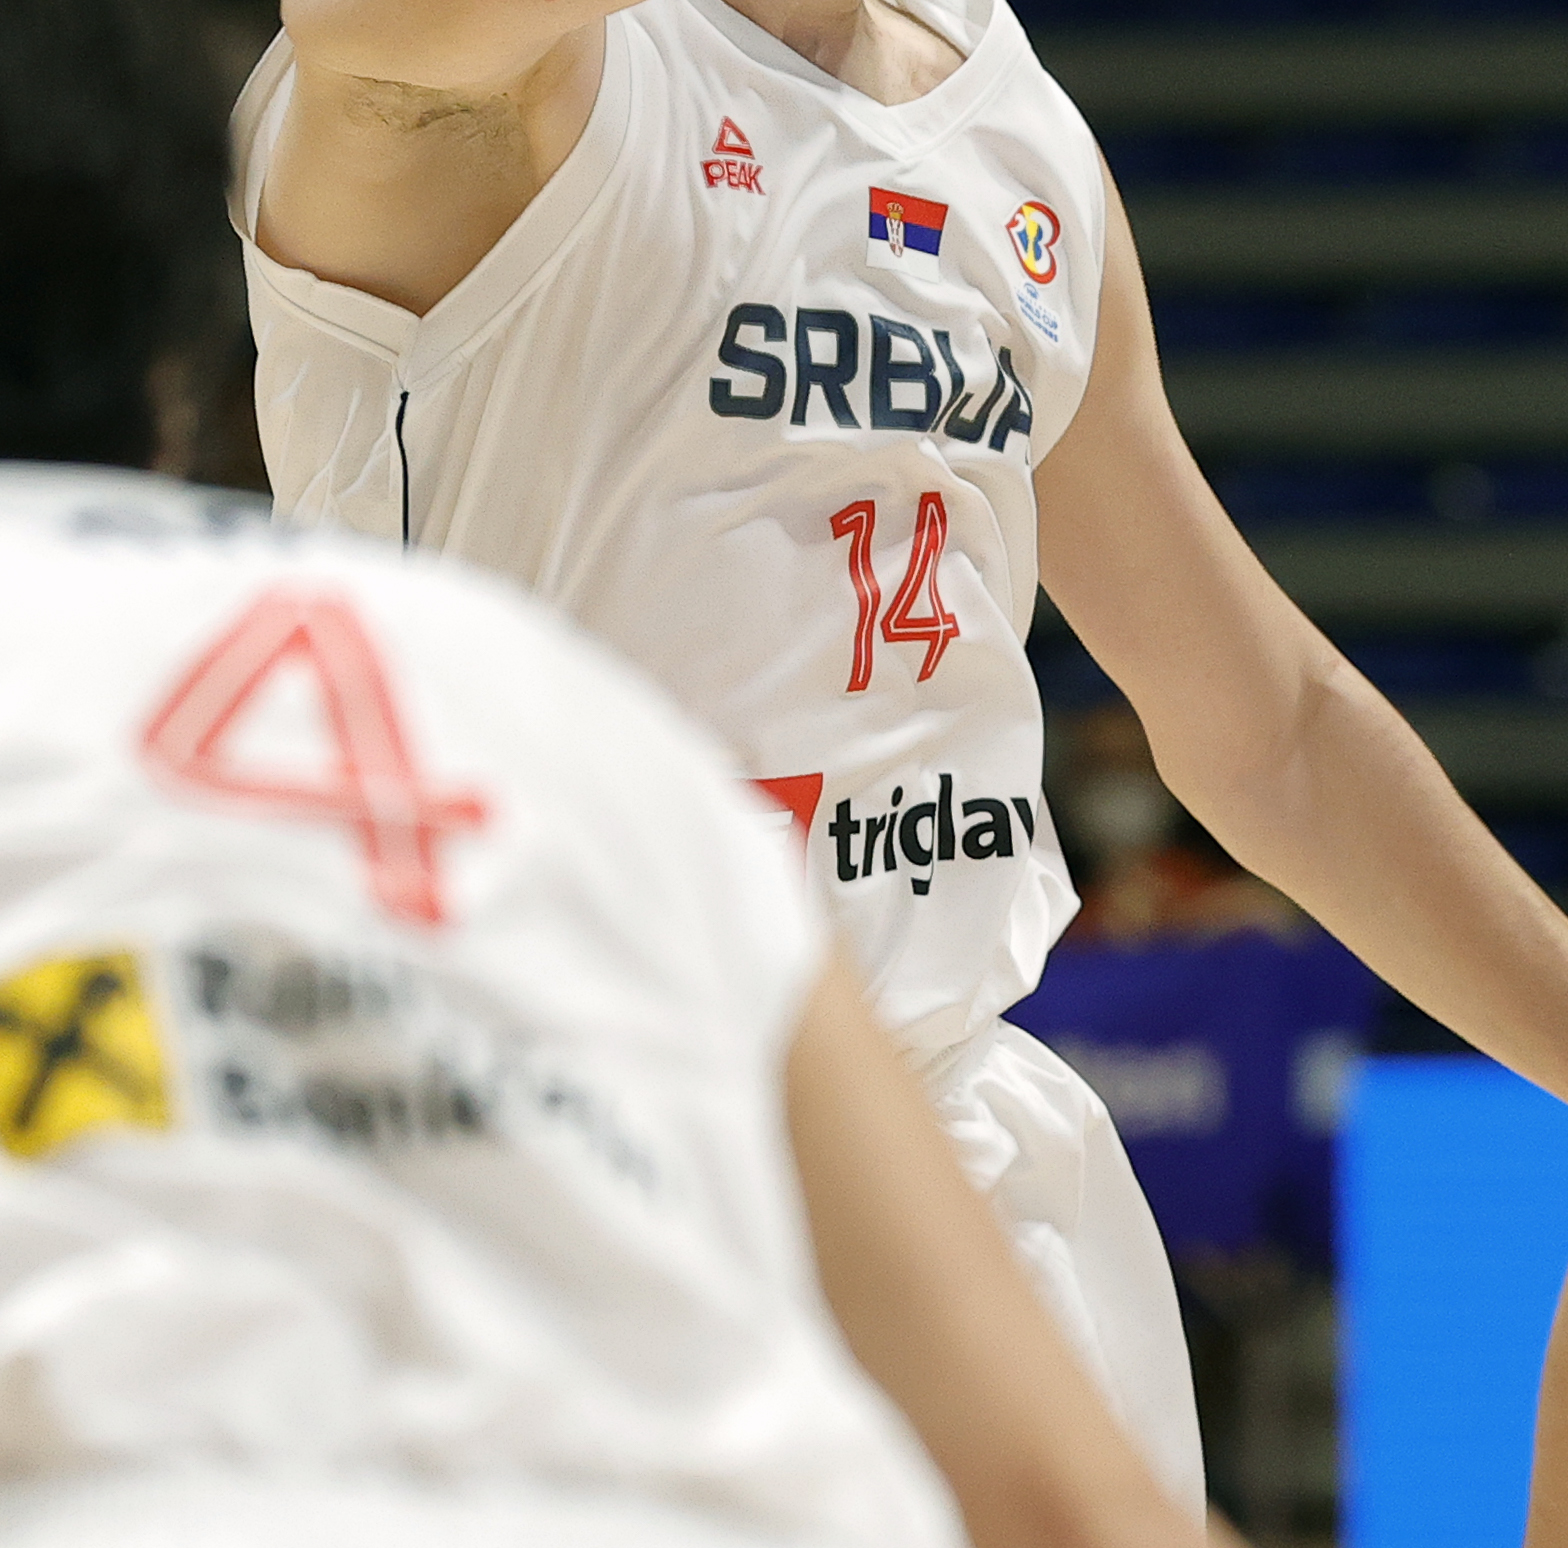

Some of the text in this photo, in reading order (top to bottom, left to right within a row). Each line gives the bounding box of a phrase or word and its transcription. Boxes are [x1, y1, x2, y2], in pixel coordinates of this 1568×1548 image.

[700, 159, 766, 195] PEAK
[708, 302, 1033, 454] SRBIJA
[829, 490, 958, 692] 14
[140, 578, 492, 926] 4
